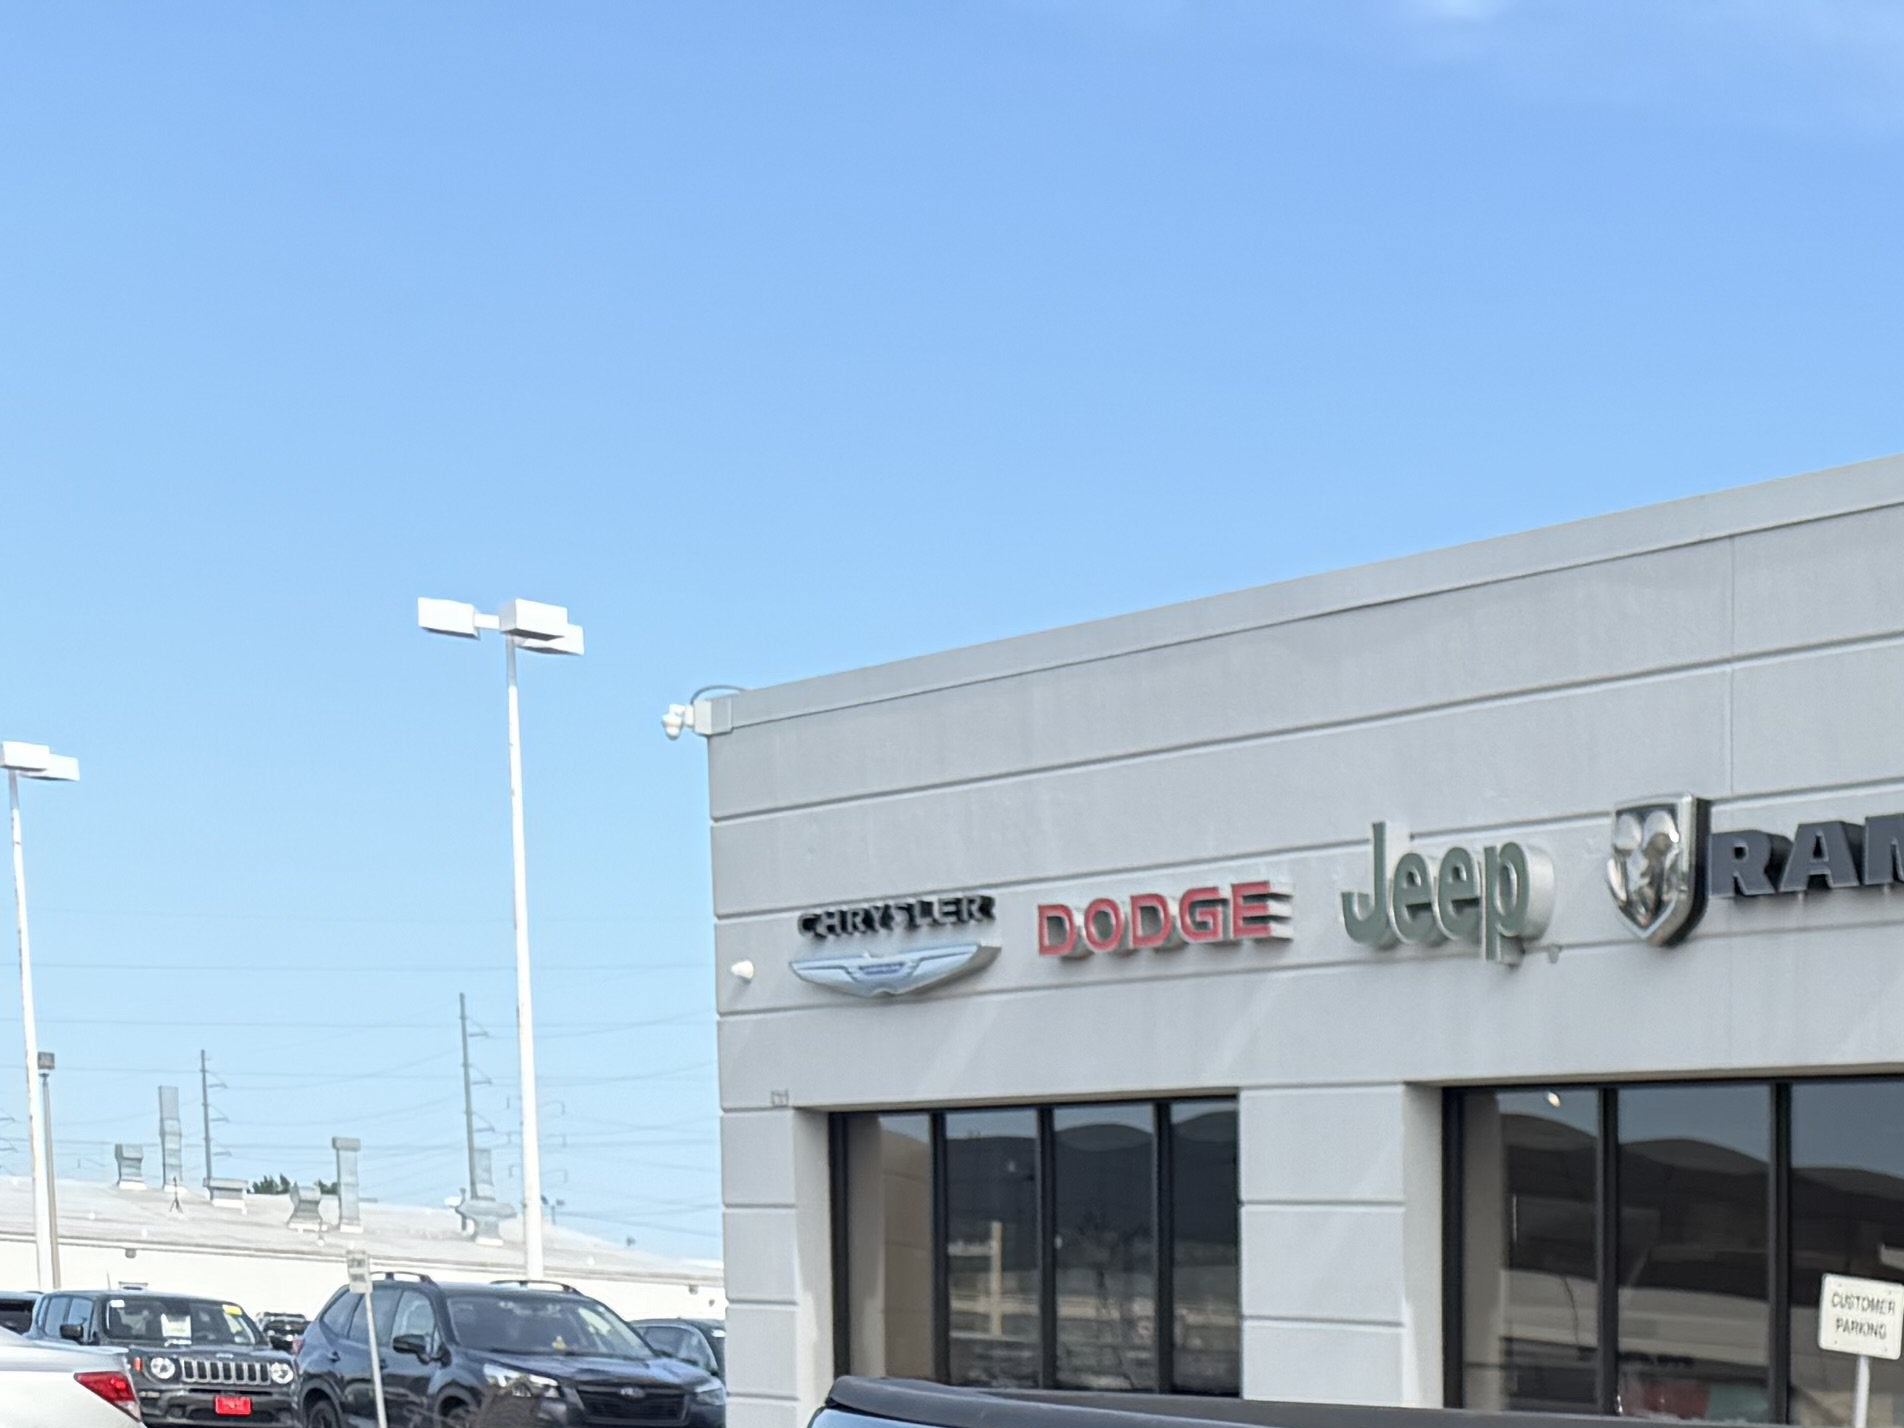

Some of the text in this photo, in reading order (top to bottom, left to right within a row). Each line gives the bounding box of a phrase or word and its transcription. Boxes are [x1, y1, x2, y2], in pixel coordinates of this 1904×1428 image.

[1341, 821, 1550, 963] Jeep
[797, 896, 996, 939] CHRYSLER
[1037, 880, 1290, 958] DODGE
[1831, 1291, 1896, 1315] CUSTOMER
[1835, 1317, 1887, 1340] PARKING
